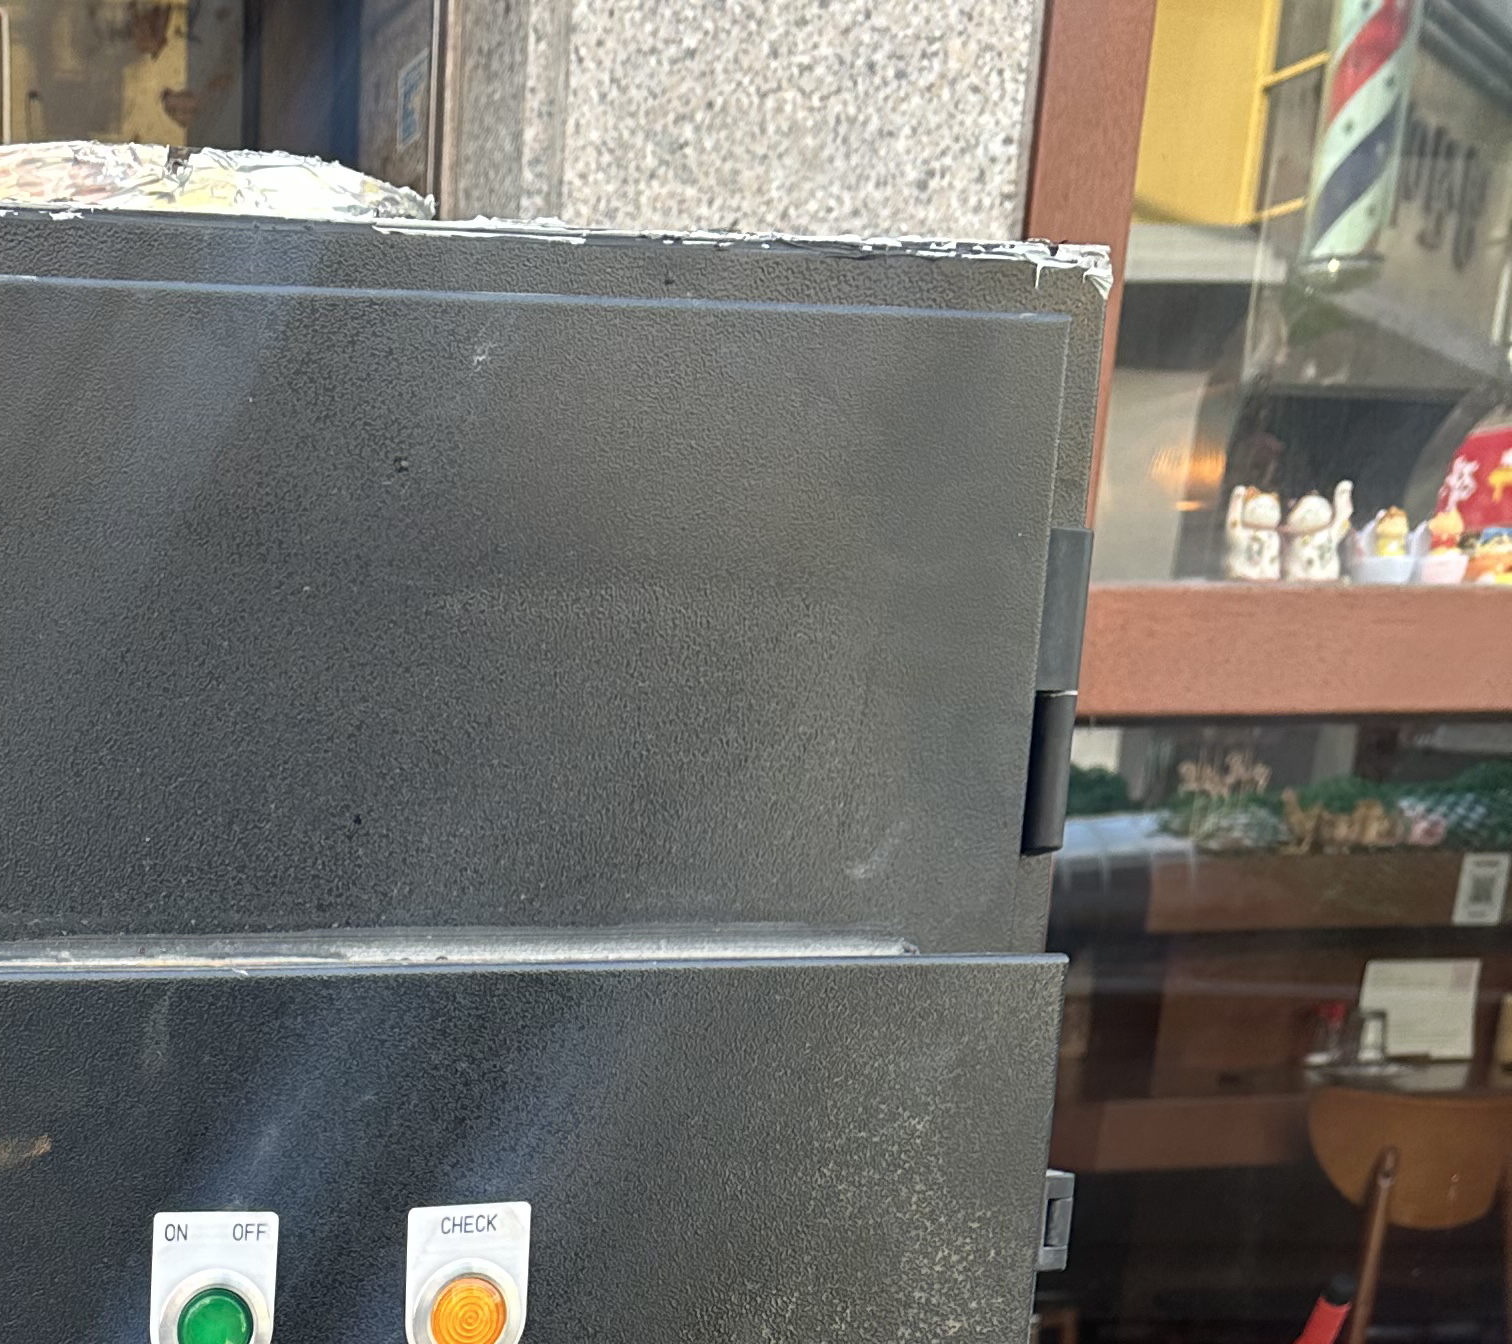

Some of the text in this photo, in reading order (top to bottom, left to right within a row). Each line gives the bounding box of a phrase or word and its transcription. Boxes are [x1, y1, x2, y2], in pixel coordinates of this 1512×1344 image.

[164, 1223, 268, 1242] ON OFF
[441, 1213, 498, 1235] CHECK
